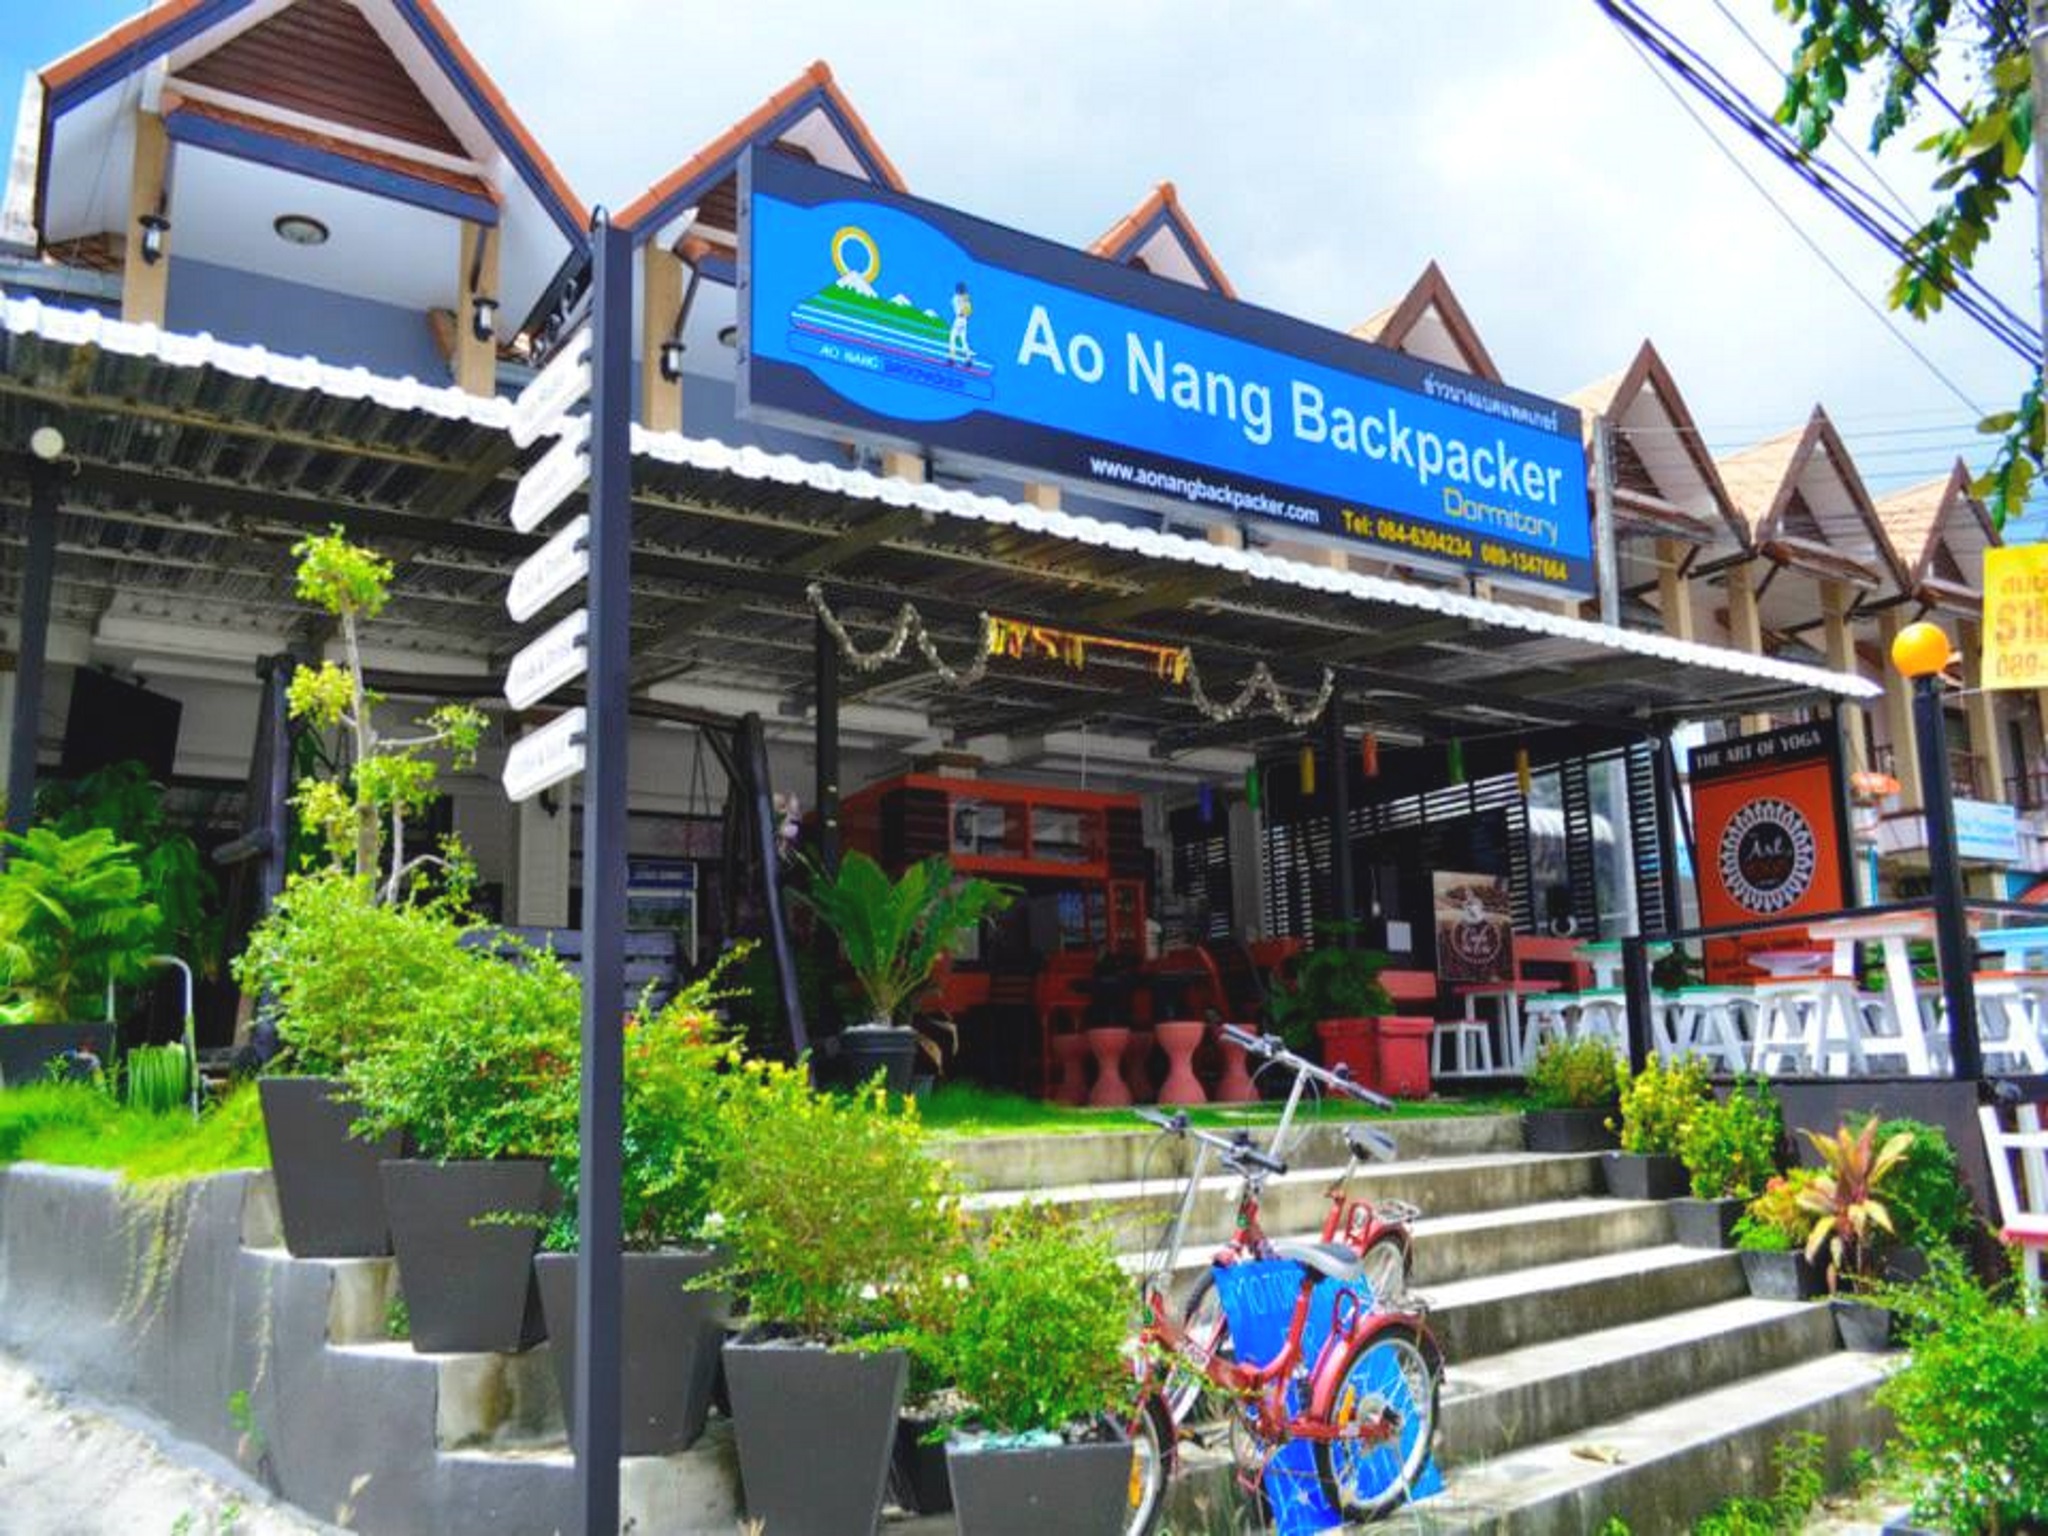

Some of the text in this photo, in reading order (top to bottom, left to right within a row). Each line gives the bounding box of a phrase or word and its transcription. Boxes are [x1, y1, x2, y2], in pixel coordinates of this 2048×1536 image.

[1017, 304, 1563, 506] Ao Nang Backpacker
[1090, 456, 1321, 524] www.aonangbackpacker.com
[1443, 487, 1559, 546] Dormitory
[1696, 729, 1821, 770] THE ART OF YOGA
